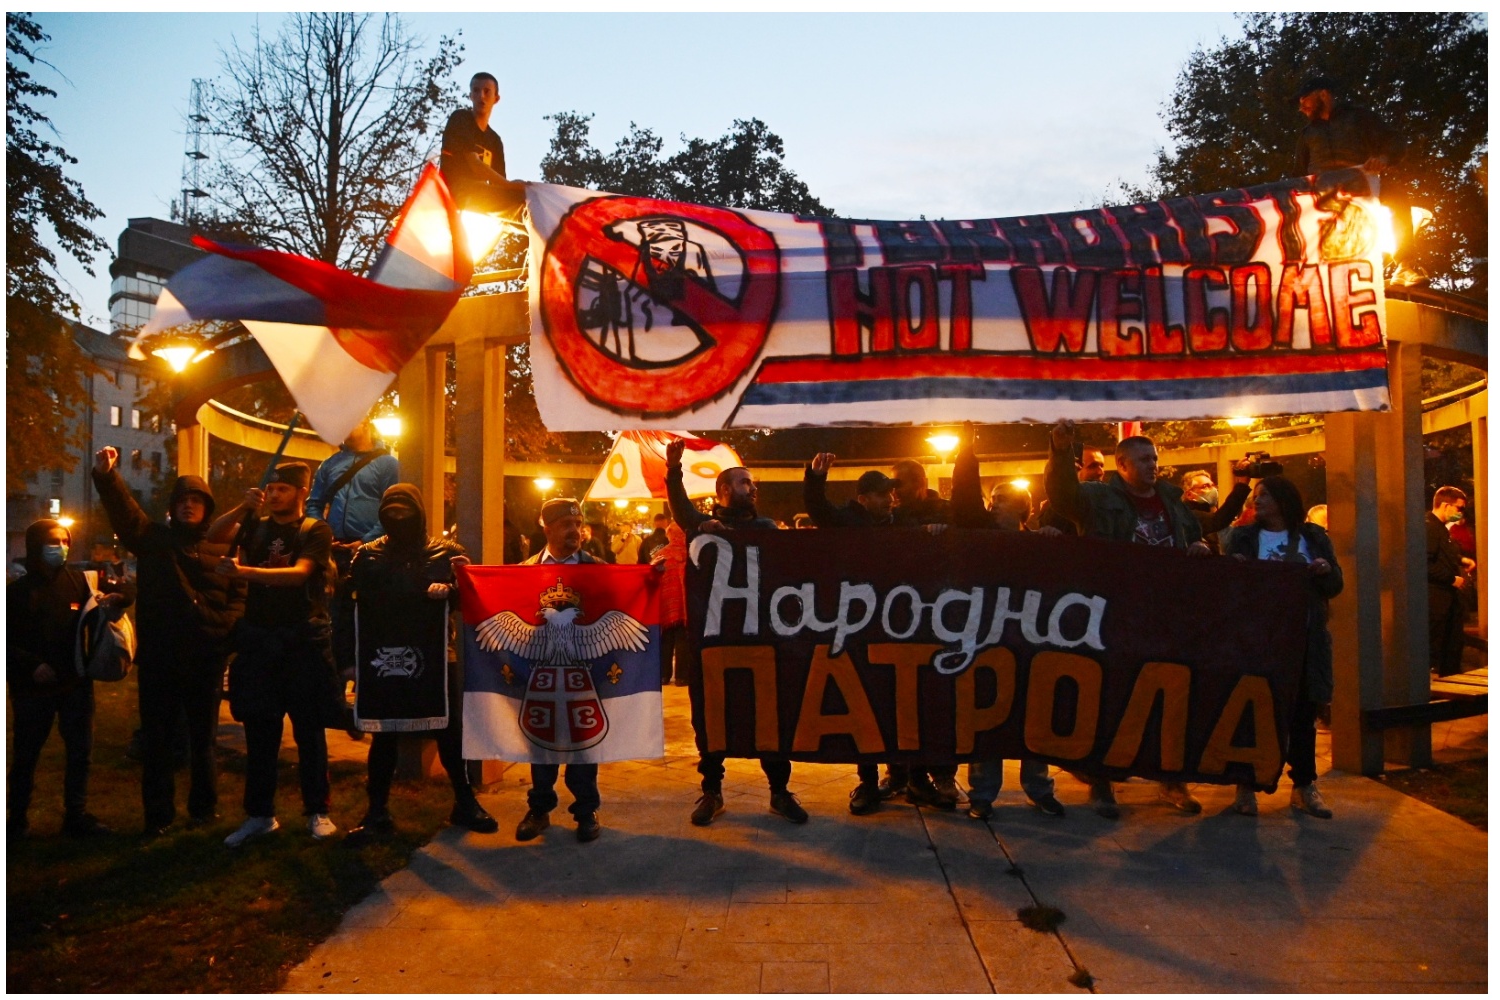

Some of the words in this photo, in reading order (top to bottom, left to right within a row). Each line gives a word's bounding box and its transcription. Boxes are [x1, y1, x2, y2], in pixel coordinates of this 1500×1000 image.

[828, 262, 986, 362] NOT
[1010, 257, 1382, 357] WELCOME
[690, 534, 1108, 675] Народна
[701, 642, 1282, 784] ПАТРОЛА
